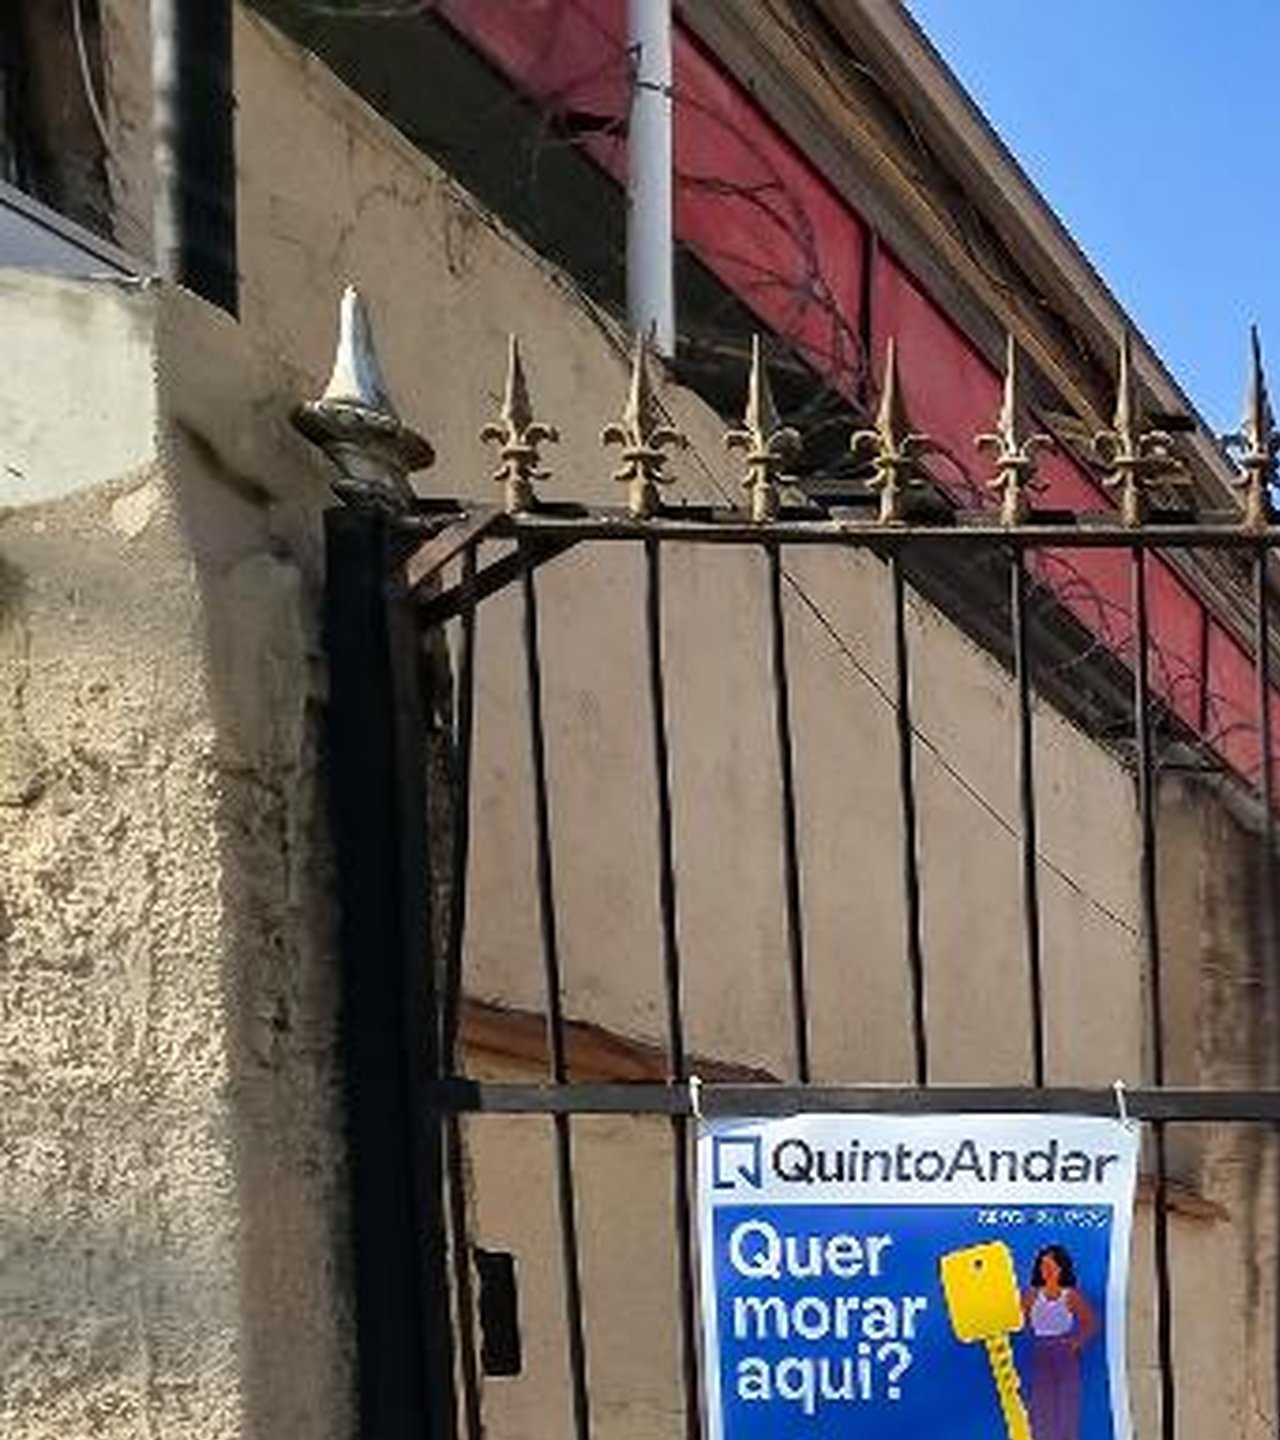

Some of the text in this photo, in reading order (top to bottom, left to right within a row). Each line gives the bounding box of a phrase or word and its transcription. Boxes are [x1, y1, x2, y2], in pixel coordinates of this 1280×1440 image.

[772, 1138, 1119, 1185] QuintoAndar
[729, 1219, 893, 1280] Quer
[733, 1296, 928, 1340] morar
[736, 1342, 914, 1413] aqui?
